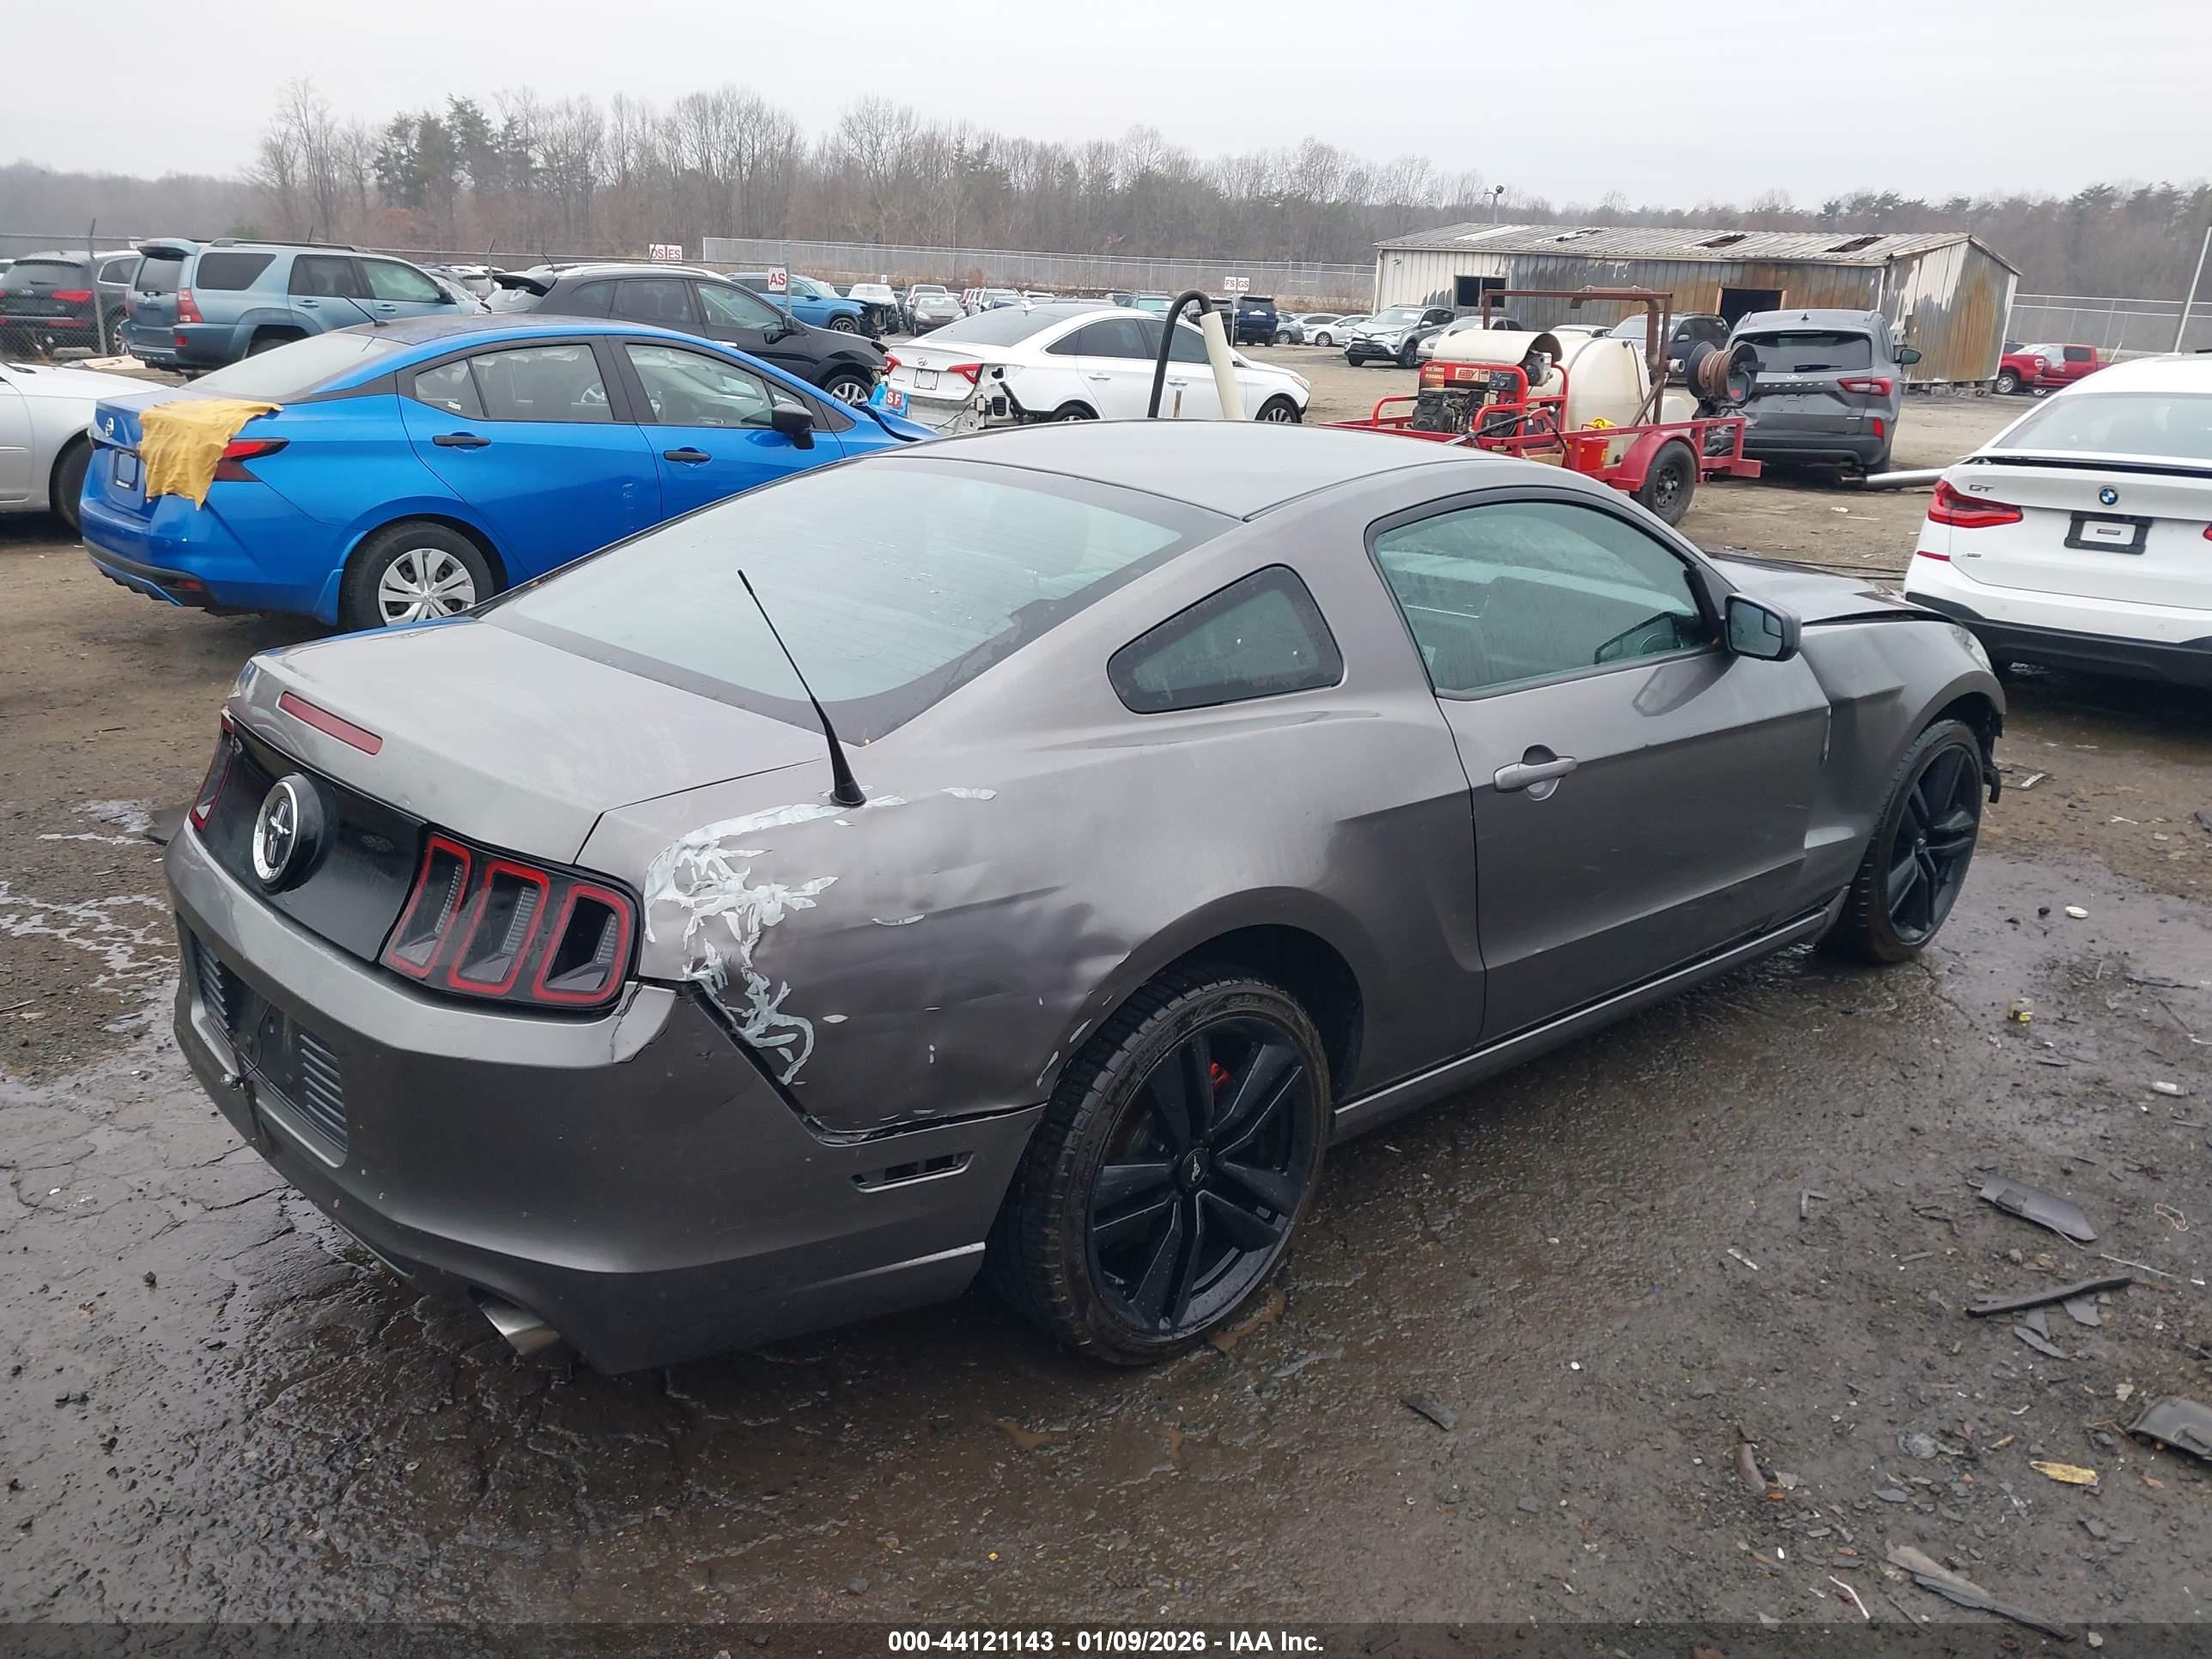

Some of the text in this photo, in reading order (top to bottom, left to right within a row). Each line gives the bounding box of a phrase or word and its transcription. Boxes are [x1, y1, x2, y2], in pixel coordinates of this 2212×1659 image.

[668, 249, 680, 259] ES
[769, 273, 786, 286] AS
[1225, 279, 1235, 288] FS
[1238, 280, 1249, 289] GS
[887, 392, 901, 404] SF
